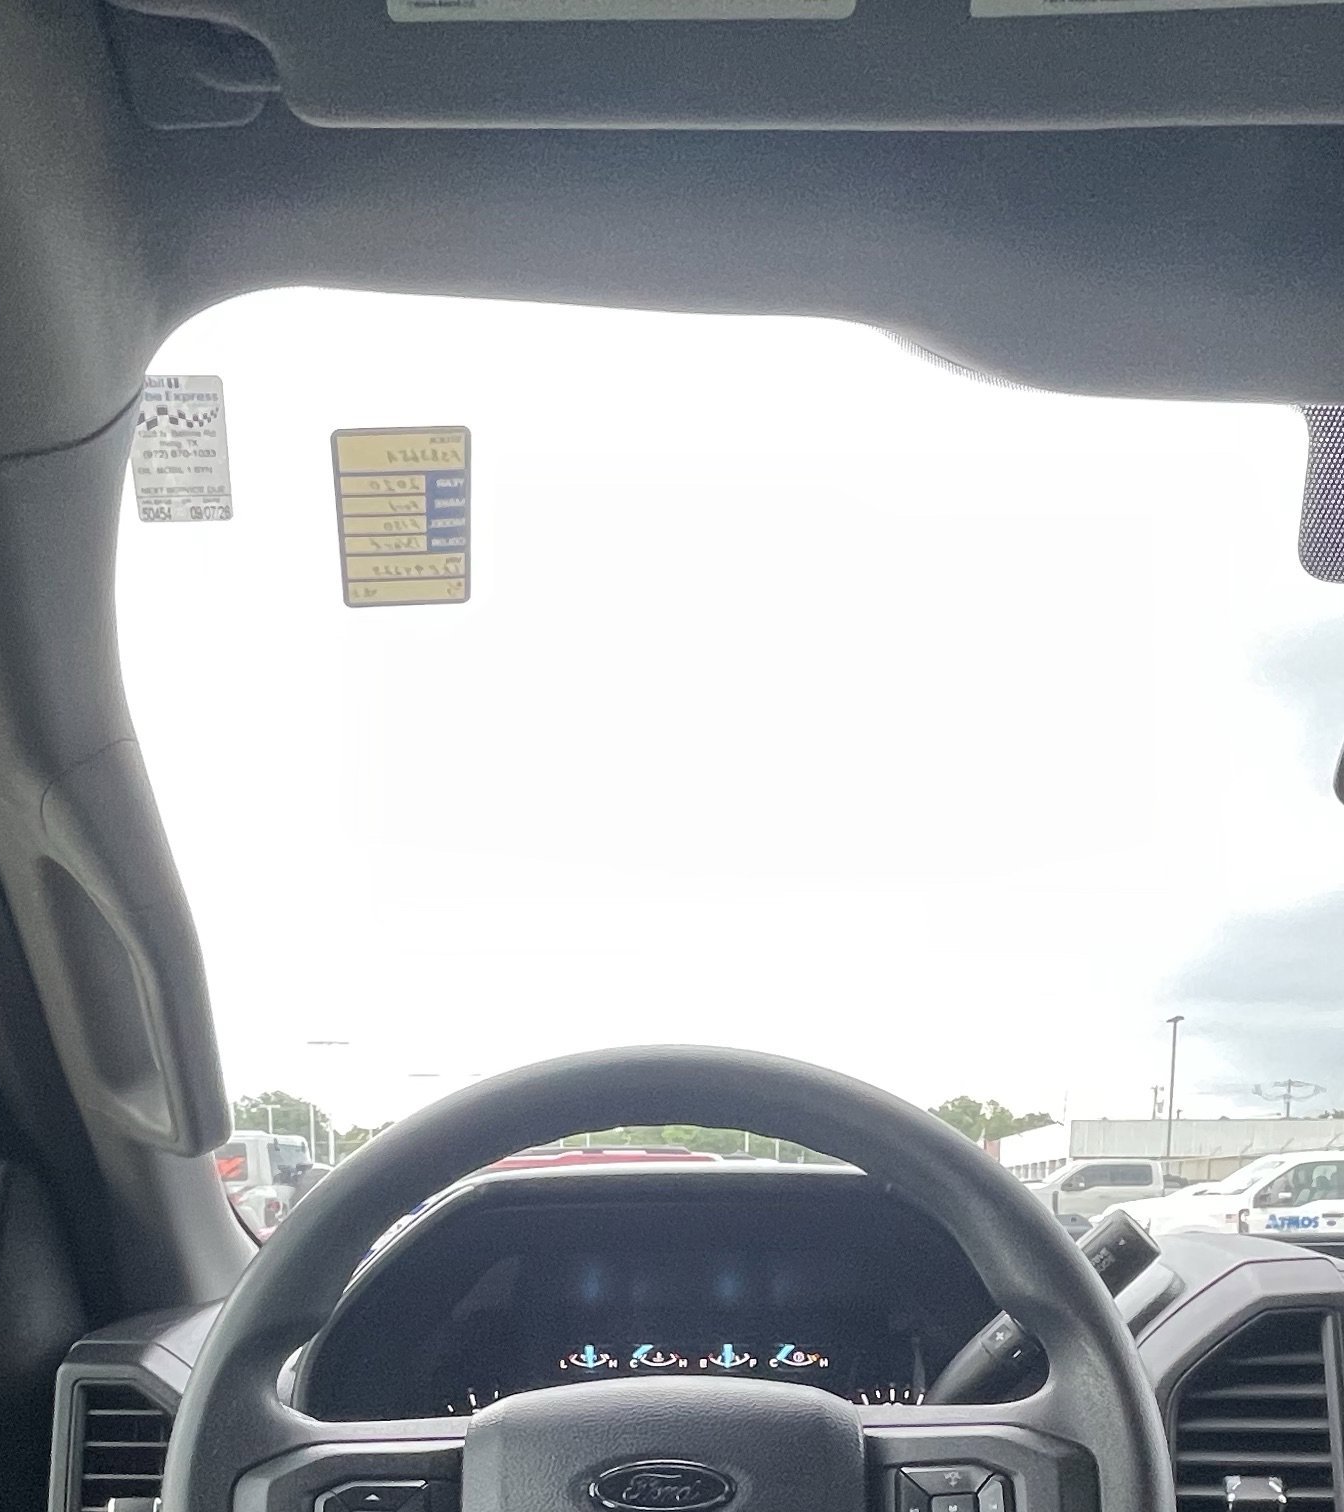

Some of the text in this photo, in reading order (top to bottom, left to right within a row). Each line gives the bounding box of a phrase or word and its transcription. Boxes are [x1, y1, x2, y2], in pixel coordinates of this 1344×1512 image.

[630, 1360, 638, 1368] C
[679, 1360, 687, 1368] H
[769, 1360, 778, 1368] C
[820, 1360, 828, 1368] H
[622, 1472, 703, 1502] Ford
